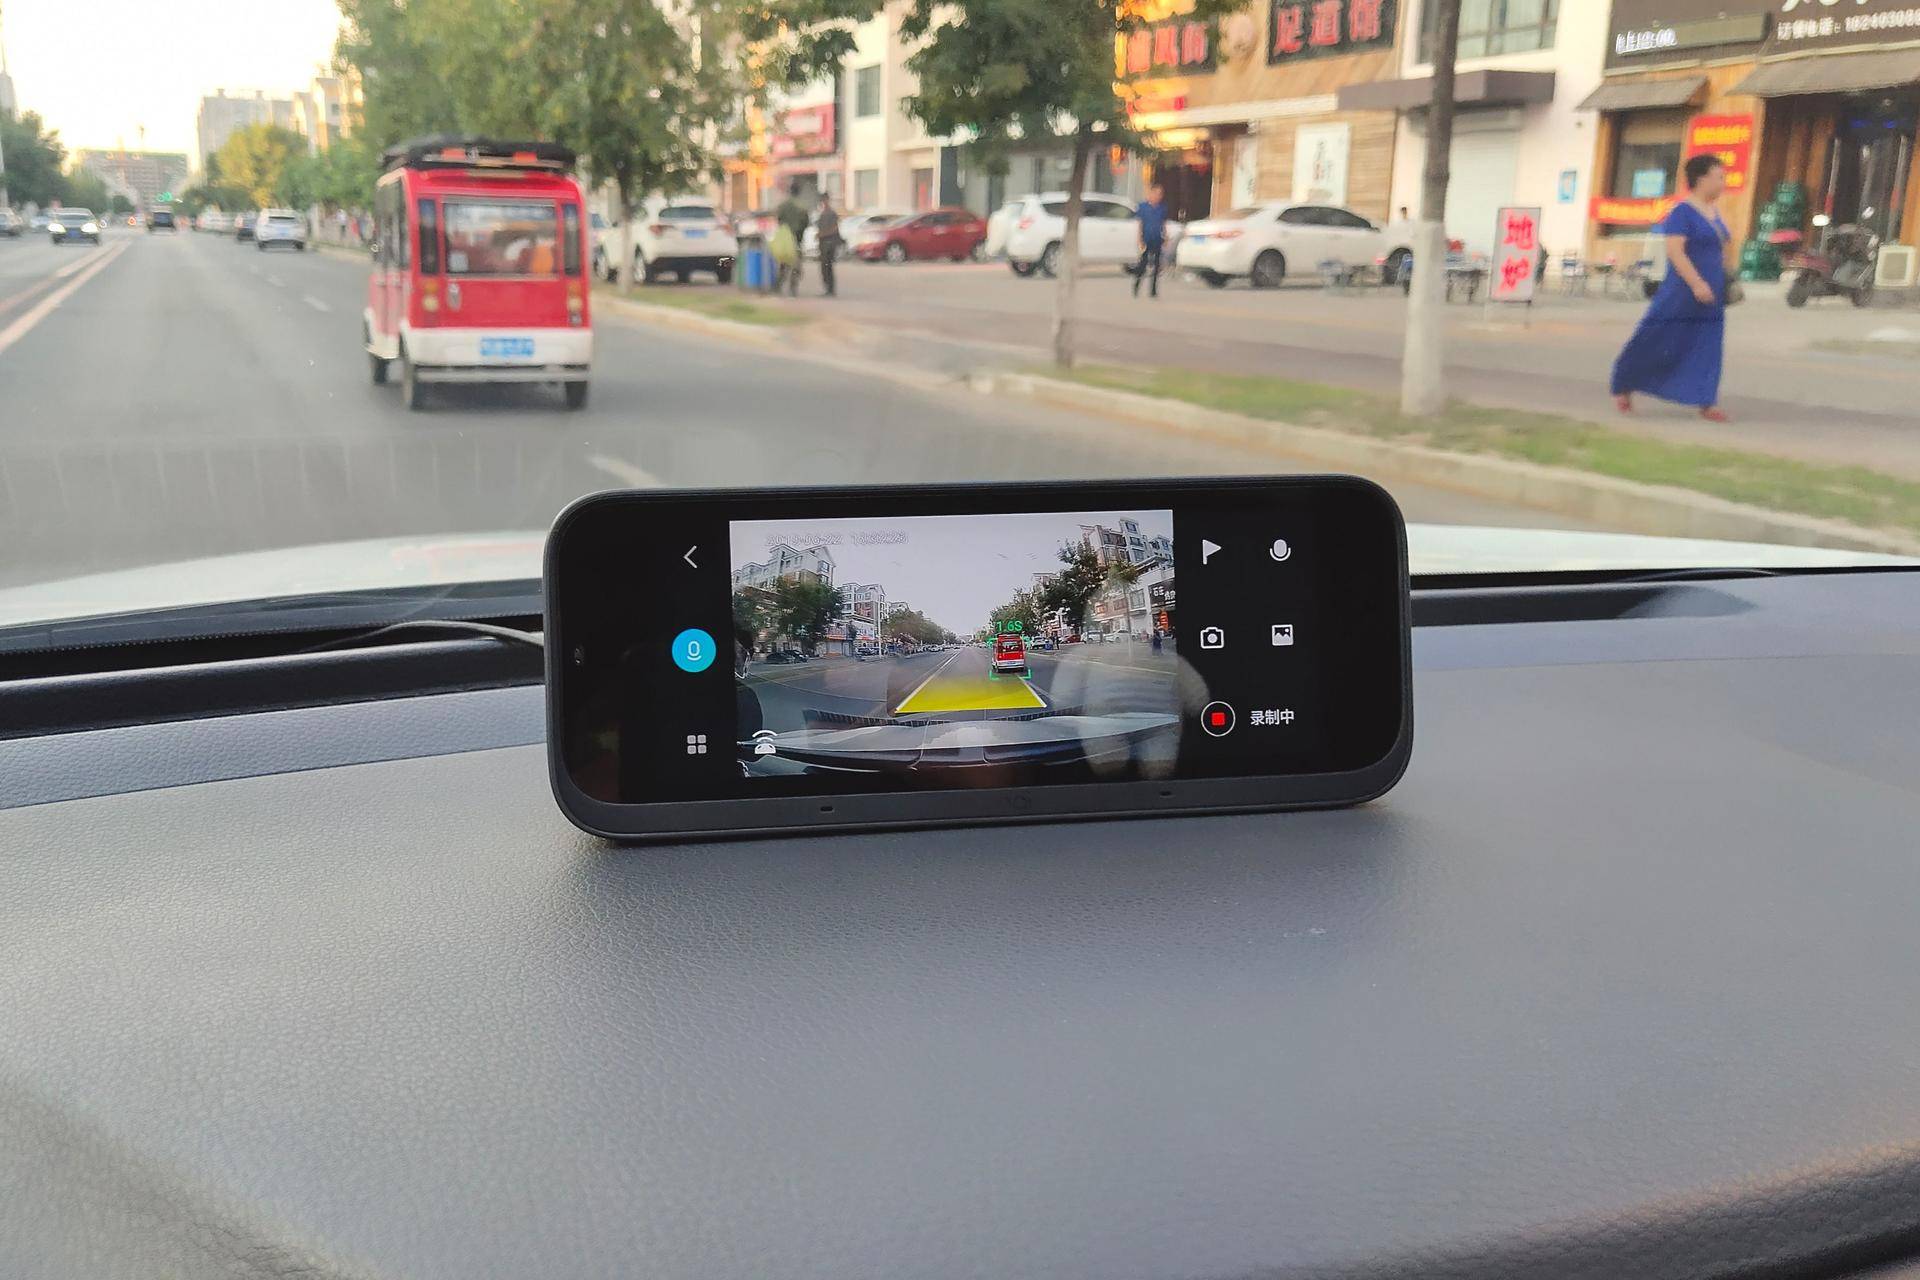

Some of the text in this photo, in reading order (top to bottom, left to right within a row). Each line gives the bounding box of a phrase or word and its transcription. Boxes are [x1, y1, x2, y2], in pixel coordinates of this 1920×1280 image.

[1275, 0, 1381, 53] 足道馆
[1250, 708, 1294, 726] 录制中
